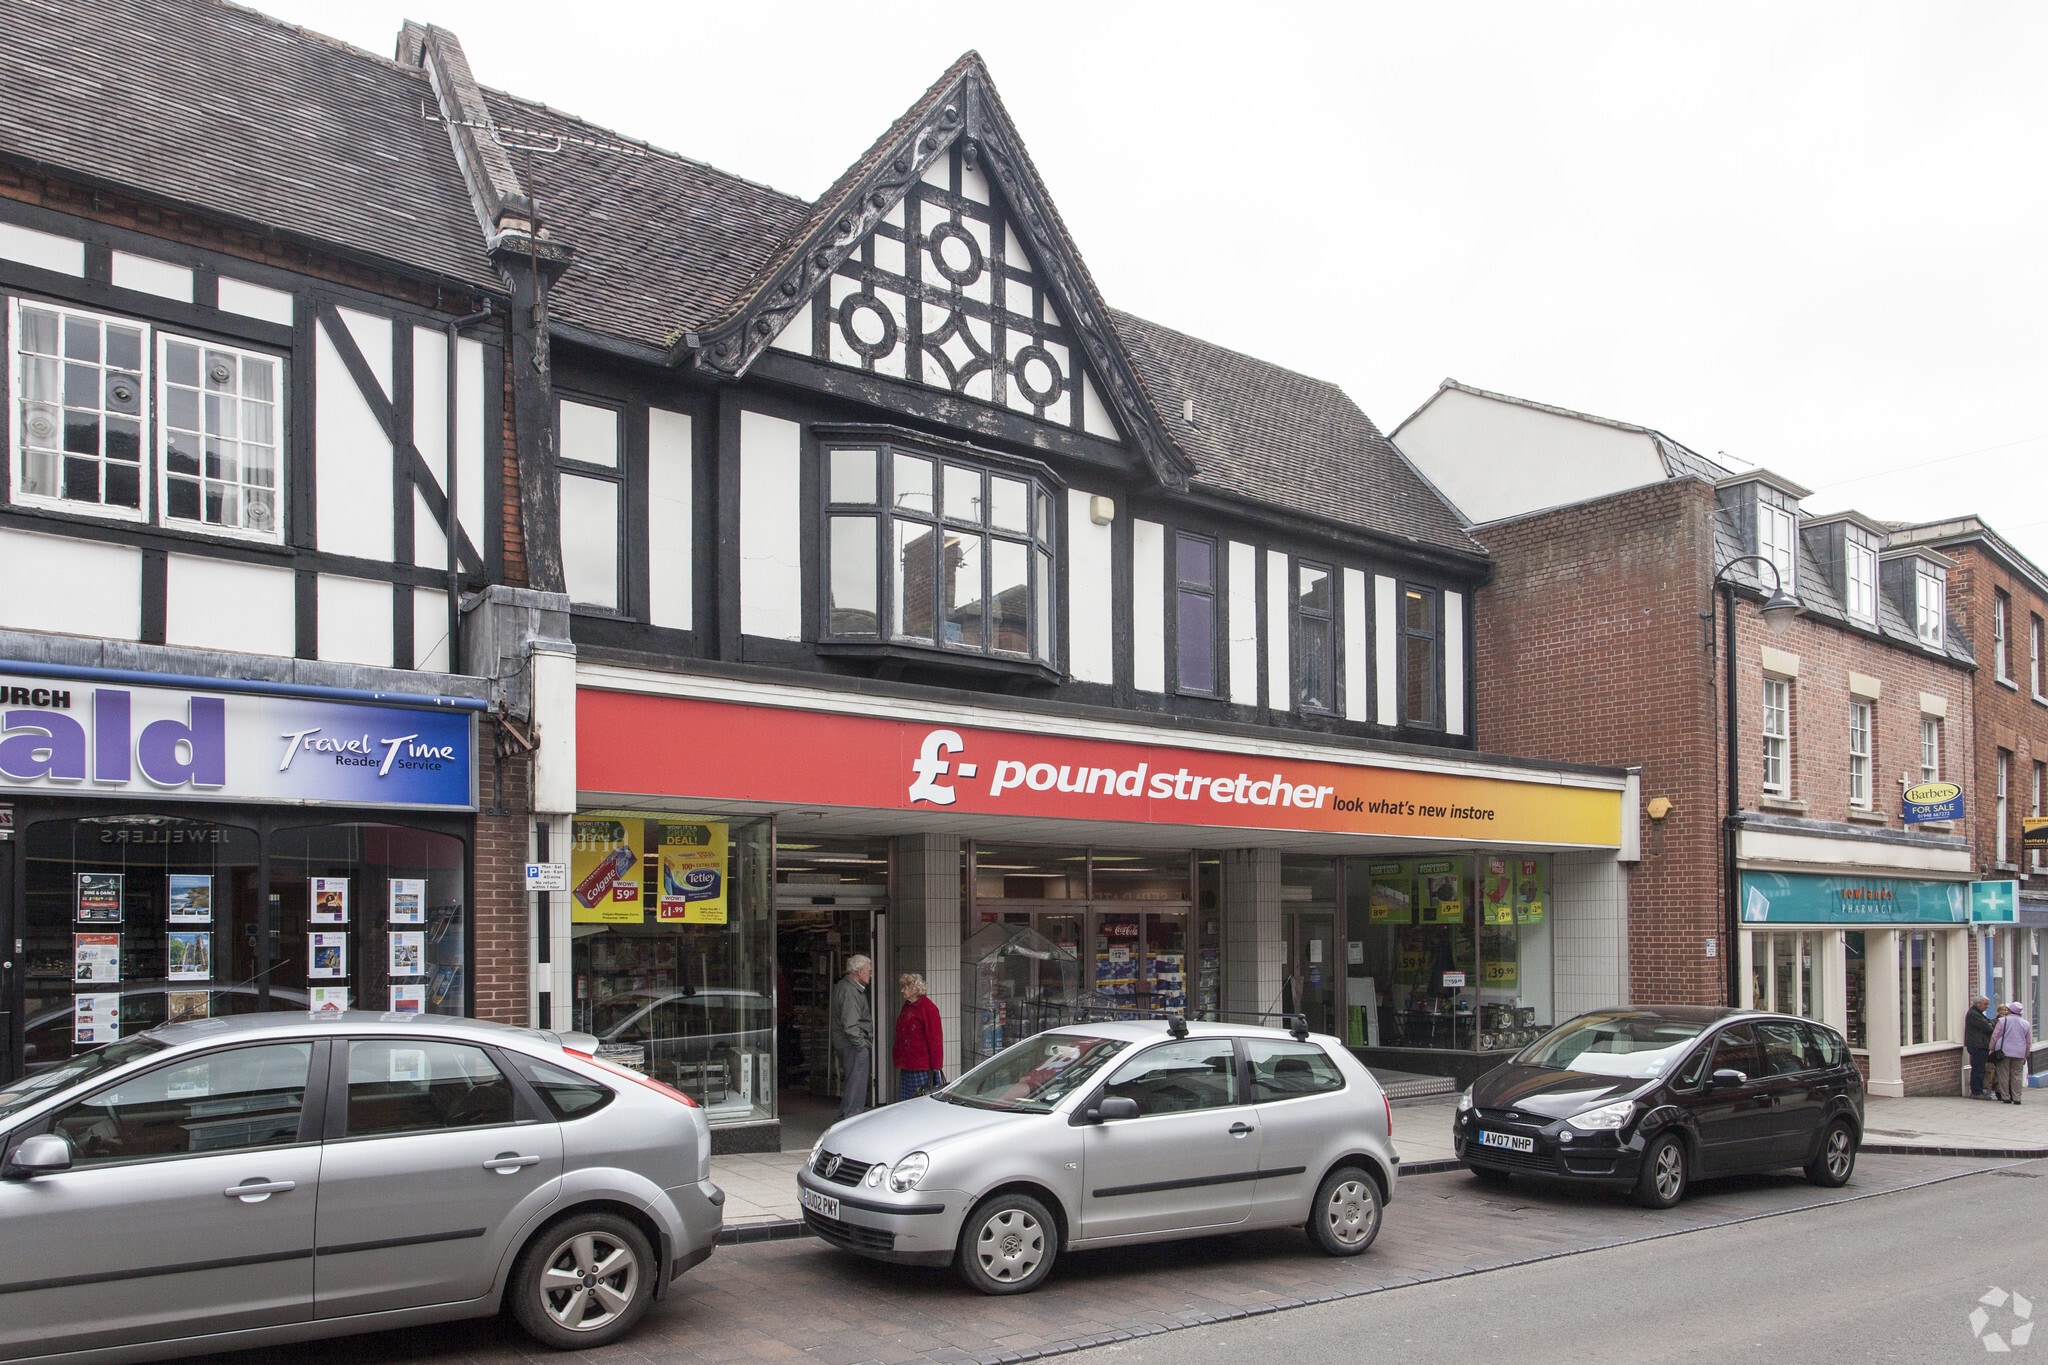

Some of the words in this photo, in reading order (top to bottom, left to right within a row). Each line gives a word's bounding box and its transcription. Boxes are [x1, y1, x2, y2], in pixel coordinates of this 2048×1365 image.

[279, 727, 372, 772] Travel
[379, 734, 455, 777] Time
[335, 755, 382, 768] Reader
[398, 759, 442, 771] Service
[989, 759, 1334, 810] poundstretcher
[1911, 787, 1954, 800] Barbers
[1332, 795, 1364, 813] look
[1418, 805, 1447, 819] new
[1450, 804, 1495, 821] instore
[1912, 805, 1931, 814] FOR
[1933, 803, 1955, 812] SALE
[666, 836, 698, 845] DEAL!
[529, 867, 538, 877] P
[688, 873, 716, 883] Tetley
[586, 868, 616, 901] Colgate
[1841, 886, 1894, 900] rowlands
[662, 906, 684, 917] £1.99
[1841, 904, 1893, 914] PHARMACY
[1485, 1132, 1510, 1147] AV07
[1511, 1136, 1532, 1150] NHP
